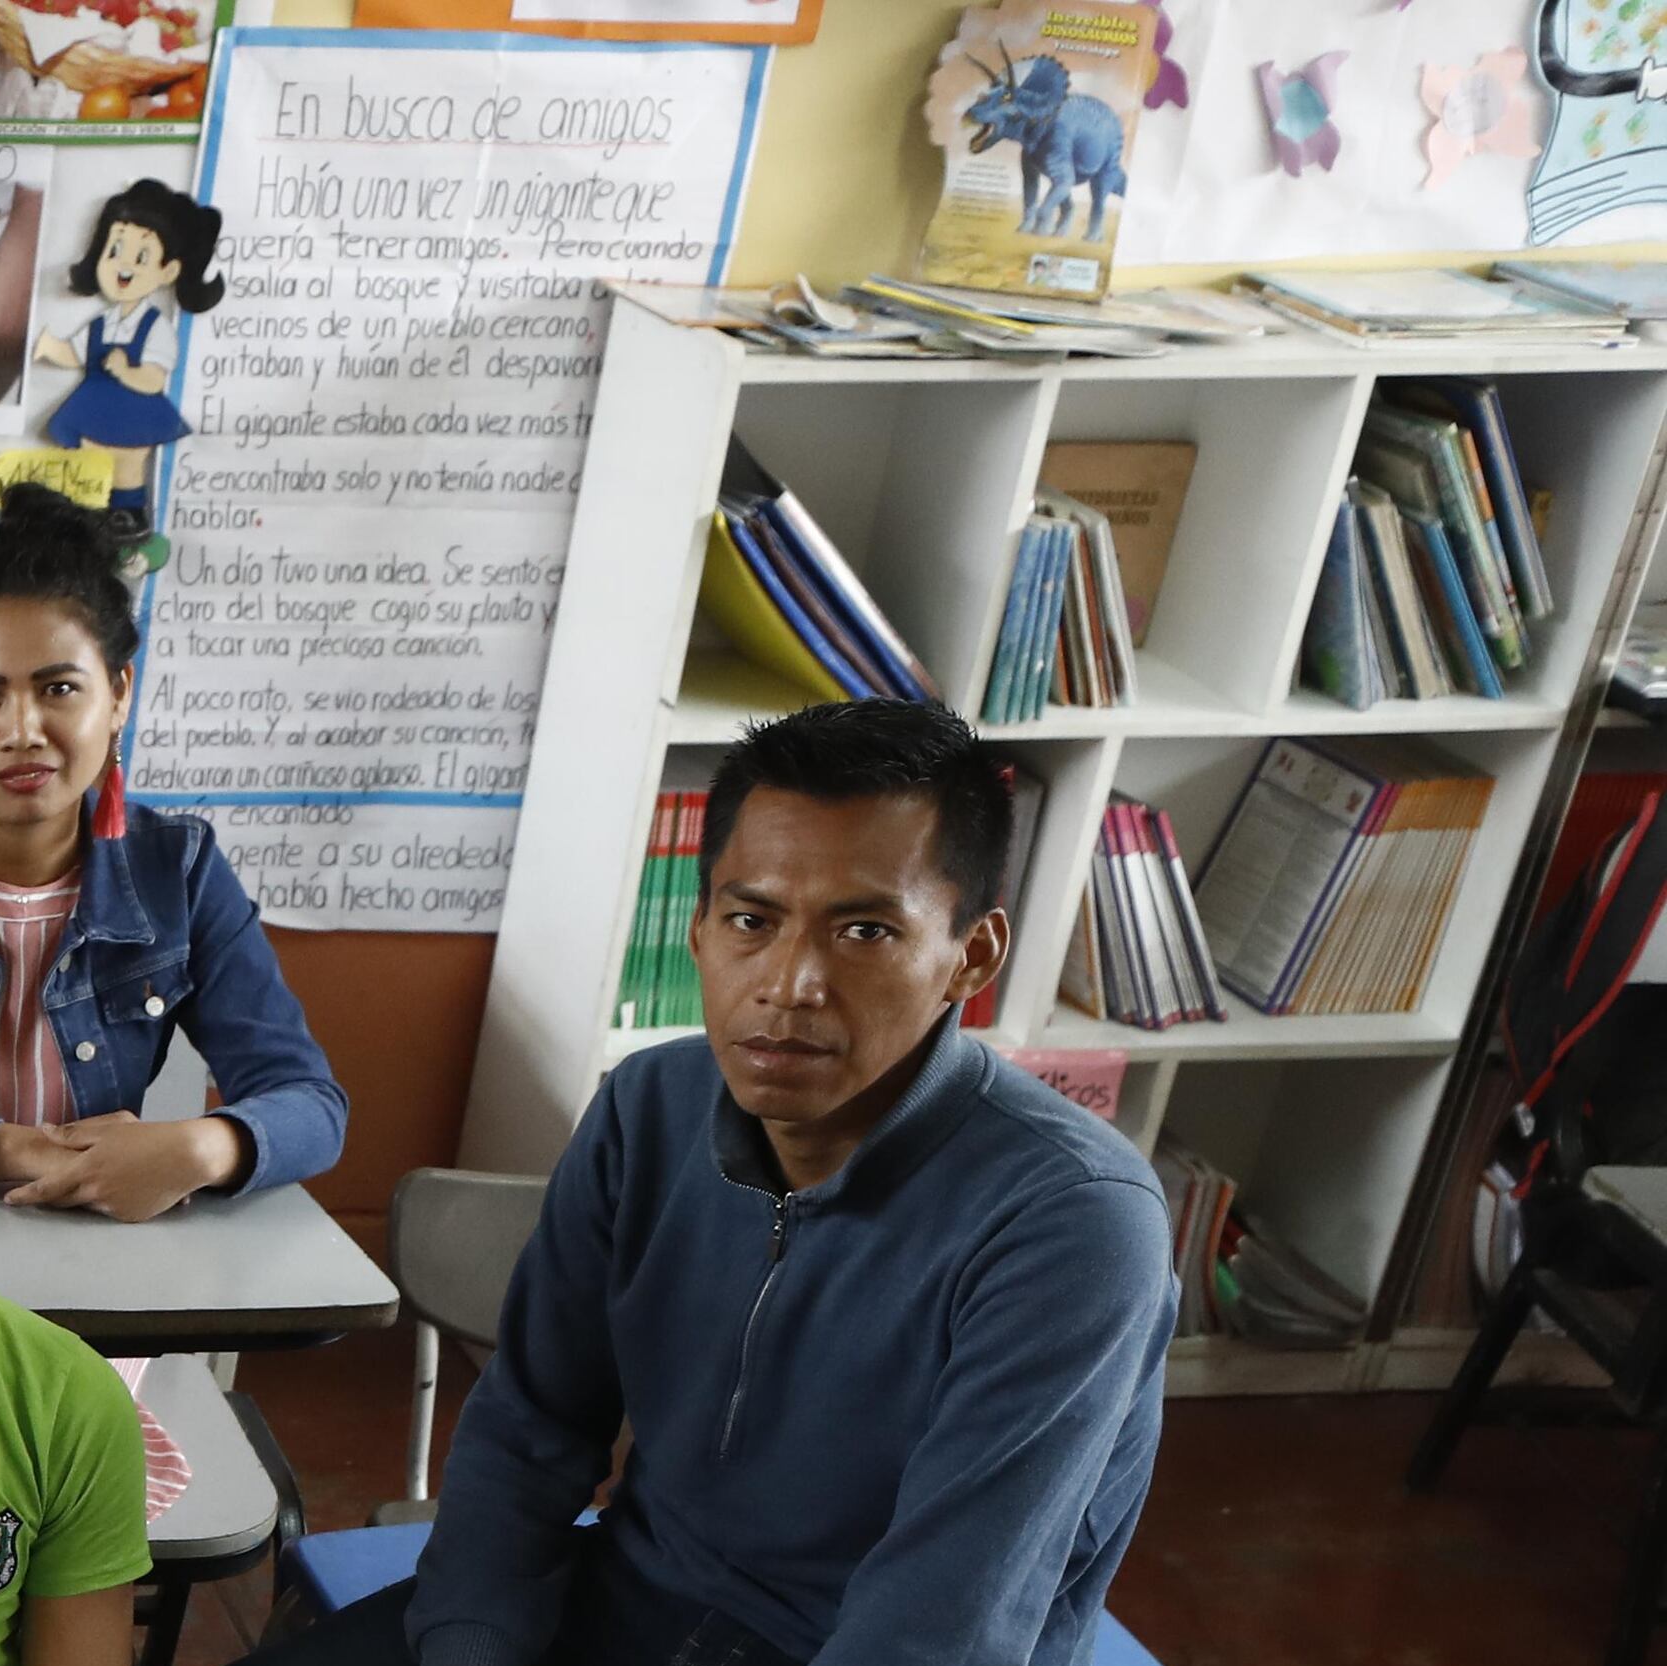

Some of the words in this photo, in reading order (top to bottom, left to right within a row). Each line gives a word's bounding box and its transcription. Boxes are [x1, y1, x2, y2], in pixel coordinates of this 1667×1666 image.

[275, 82, 318, 141] En
[345, 76, 452, 141] busca
[472, 85, 517, 142] de
[539, 92, 673, 159] amigos
[254, 157, 341, 221] Había
[352, 182, 408, 221] una
[417, 181, 456, 221] vez
[507, 168, 606, 237] gigante
[610, 179, 674, 238] que
[336, 231, 407, 261] tener
[538, 221, 605, 261] Pero
[607, 235, 703, 261] cuando
[307, 267, 331, 297] al
[355, 266, 440, 316] bosque
[456, 277, 471, 317] y
[479, 267, 582, 299] visitaba
[211, 313, 308, 338] vecinos
[318, 312, 351, 338] de
[405, 308, 483, 354] pueblo
[201, 396, 224, 437] El
[235, 405, 326, 449] gigante
[333, 402, 405, 434] estaba
[412, 403, 468, 434] cada
[476, 410, 512, 434] vez
[518, 405, 566, 432] más
